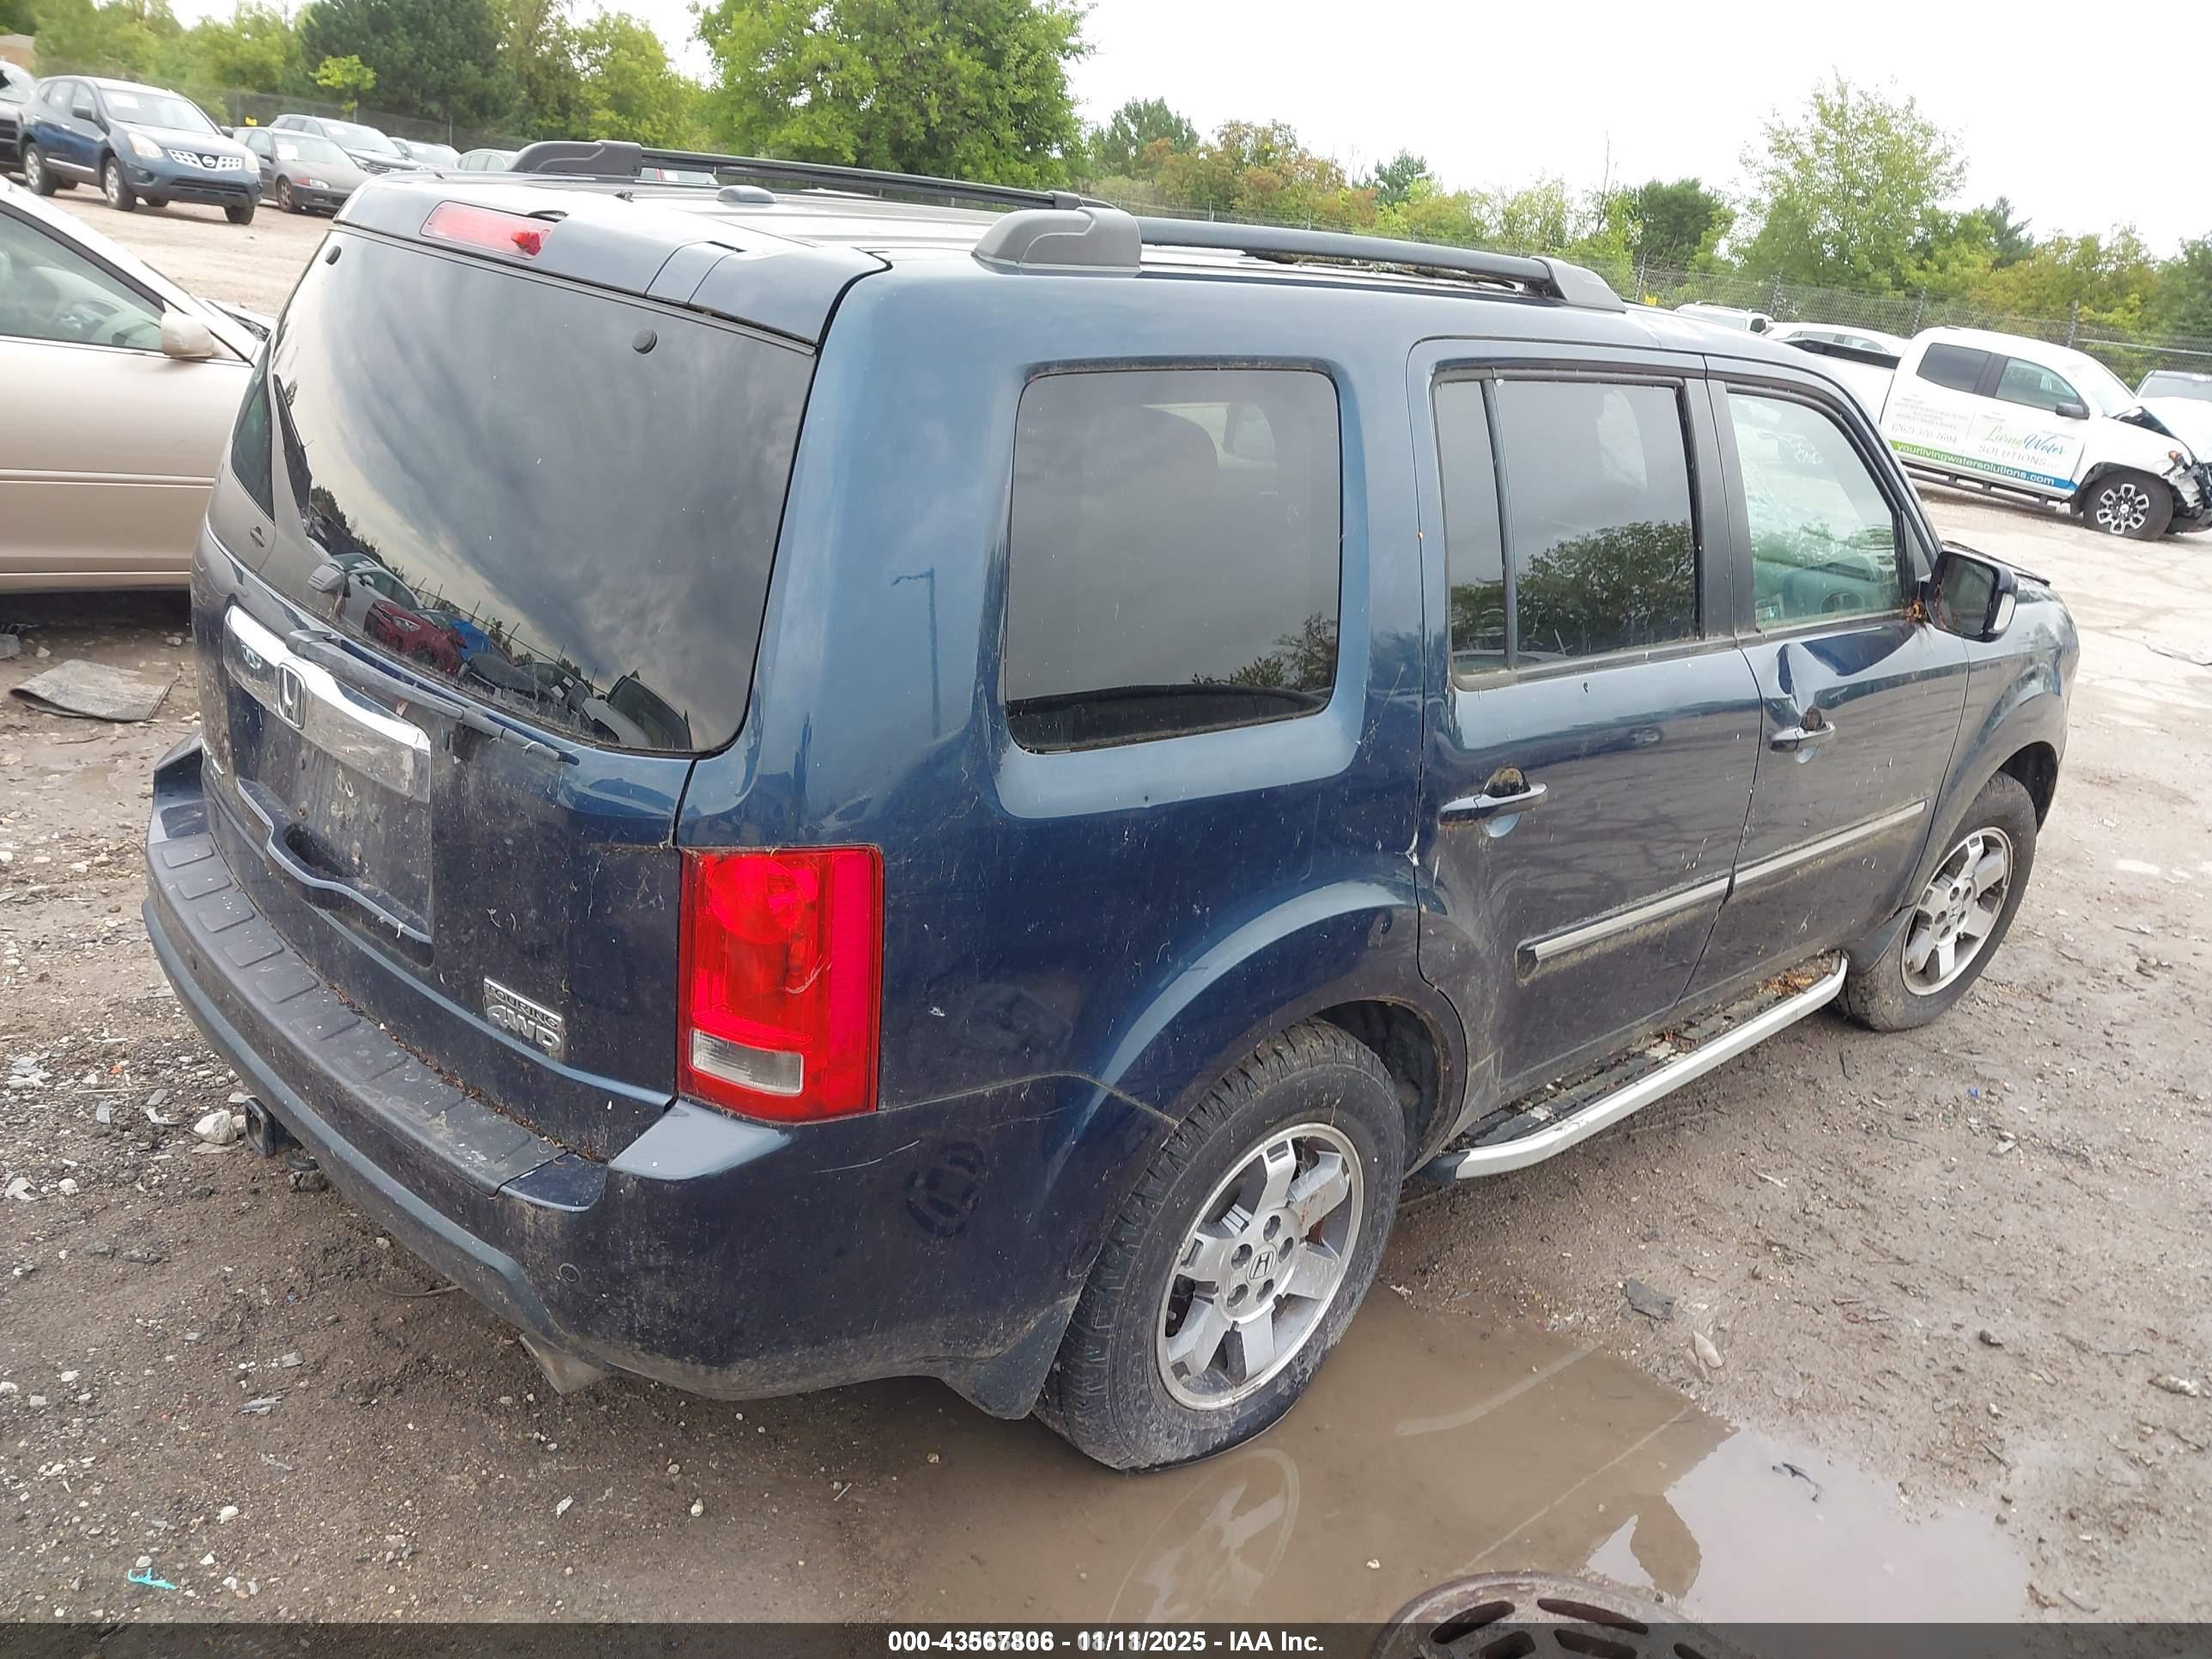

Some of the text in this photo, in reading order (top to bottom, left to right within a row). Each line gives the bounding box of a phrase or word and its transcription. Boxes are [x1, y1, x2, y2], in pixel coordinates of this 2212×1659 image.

[1896, 442, 2055, 486] yourlivingwatersolutions.com
[1978, 445, 2047, 467] SOLUTIONS
[2023, 434, 2066, 455] Water
[484, 984, 558, 1030] TOURING
[487, 1006, 560, 1049] 4WD
